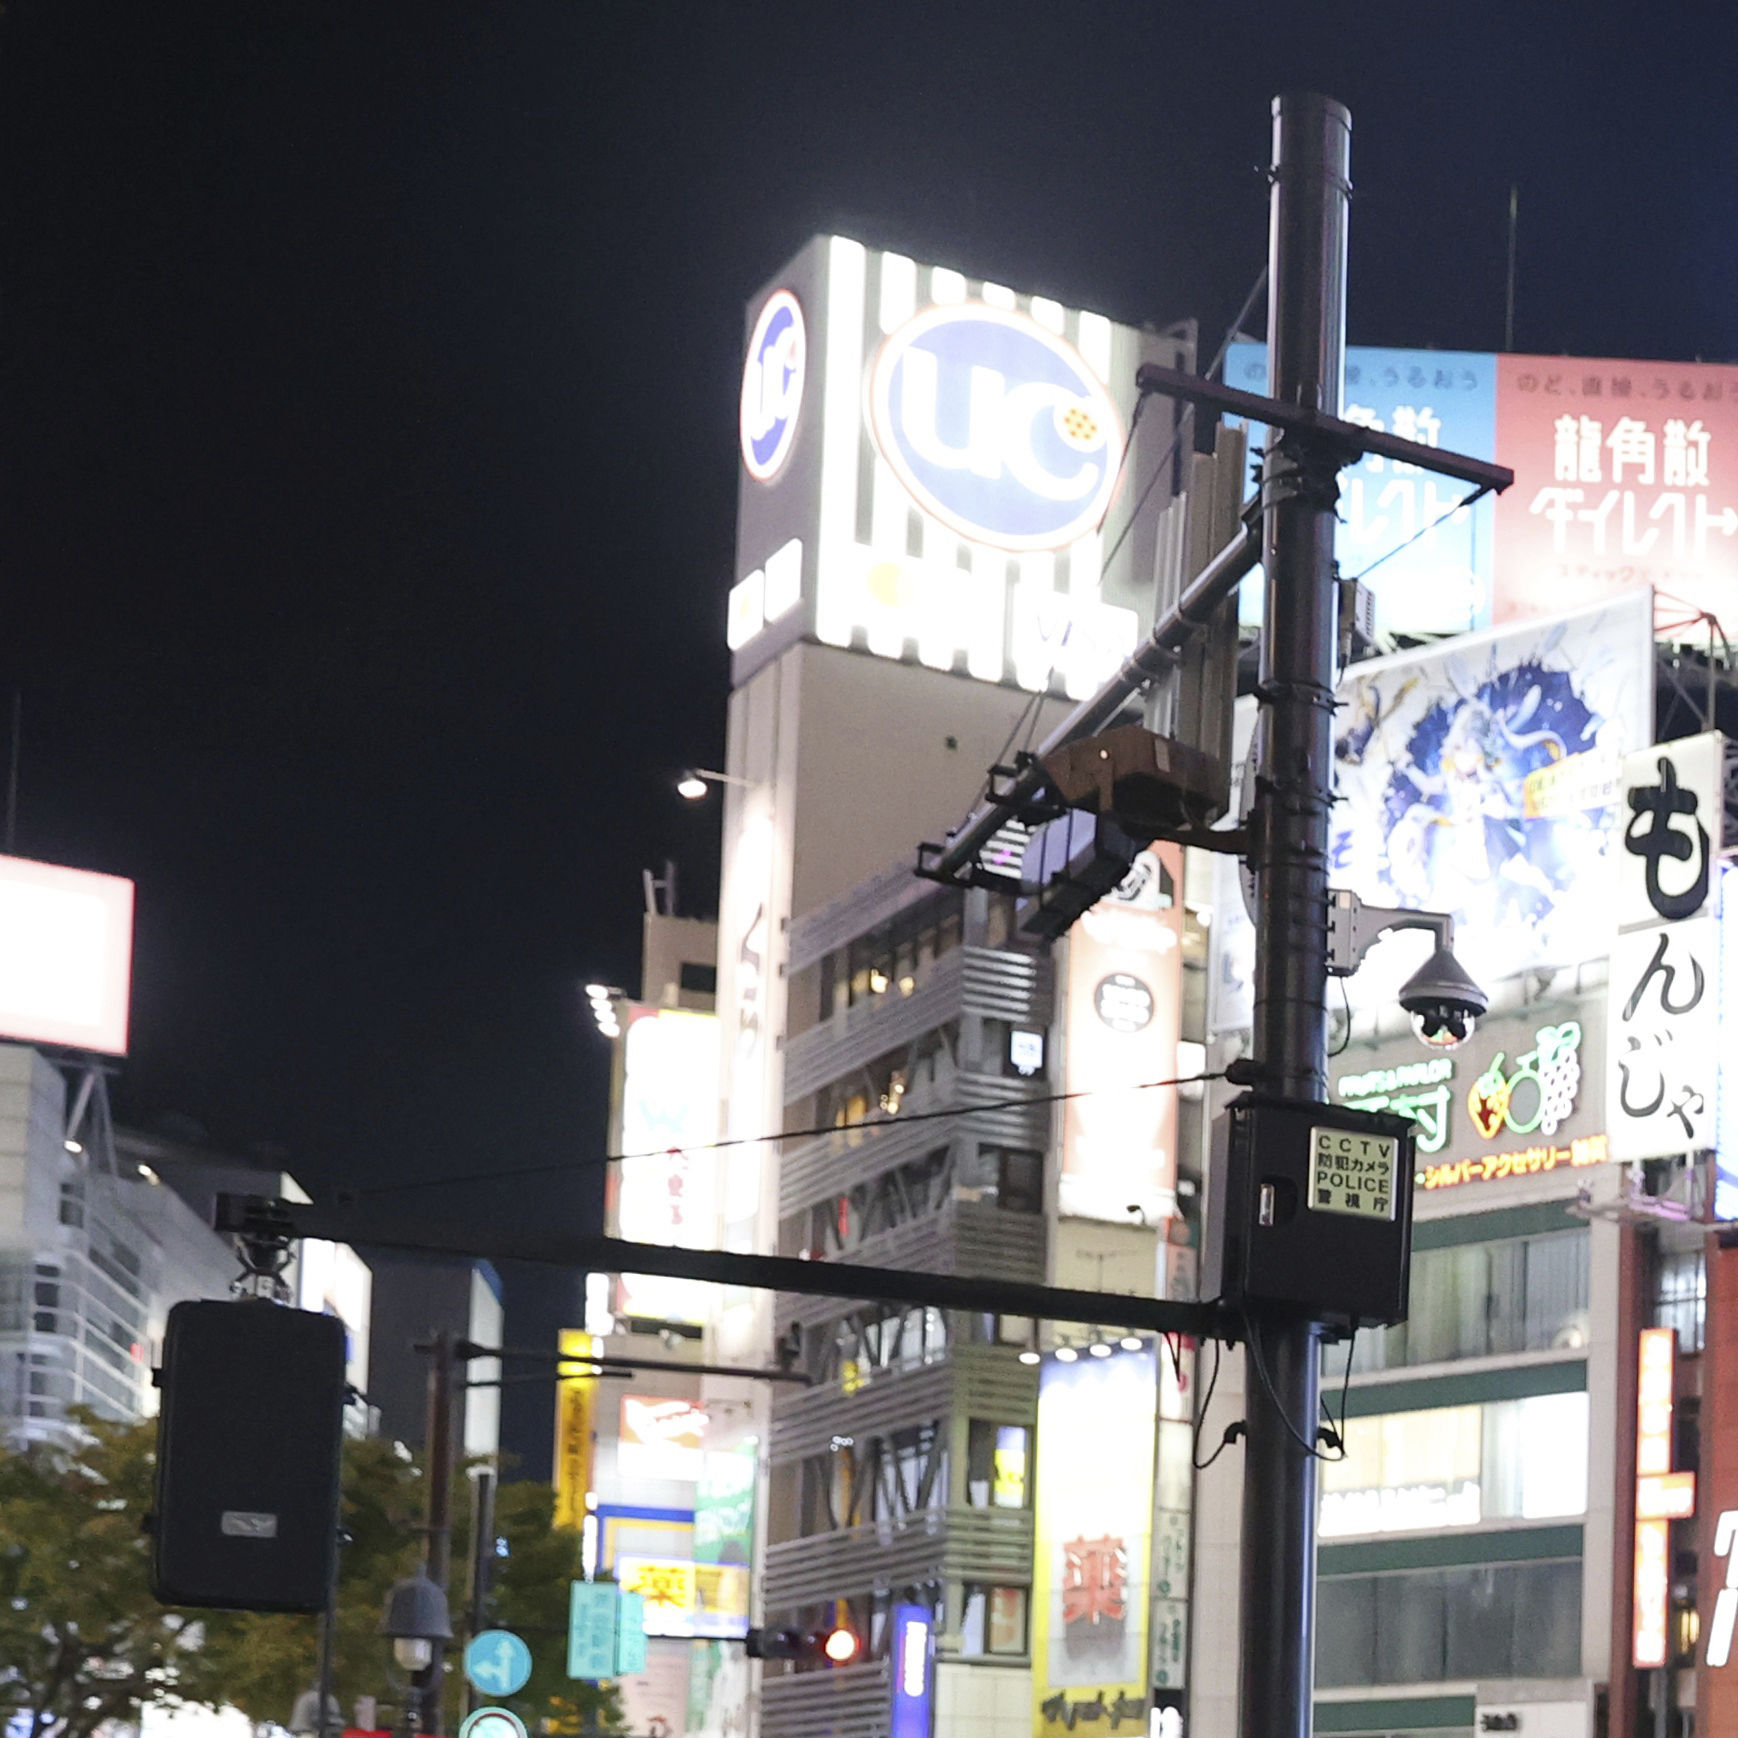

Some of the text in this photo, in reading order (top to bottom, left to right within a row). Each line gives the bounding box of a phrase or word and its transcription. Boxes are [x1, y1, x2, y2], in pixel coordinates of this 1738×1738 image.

[900, 345, 1101, 500] UC
[1554, 413, 1713, 487] 龍角散
[1618, 756, 1711, 1140] もんじゃ
[1318, 1135, 1390, 1159] CCTV
[1318, 1152, 1390, 1175] 防犯カメラ
[1317, 1171, 1389, 1194] POLICE
